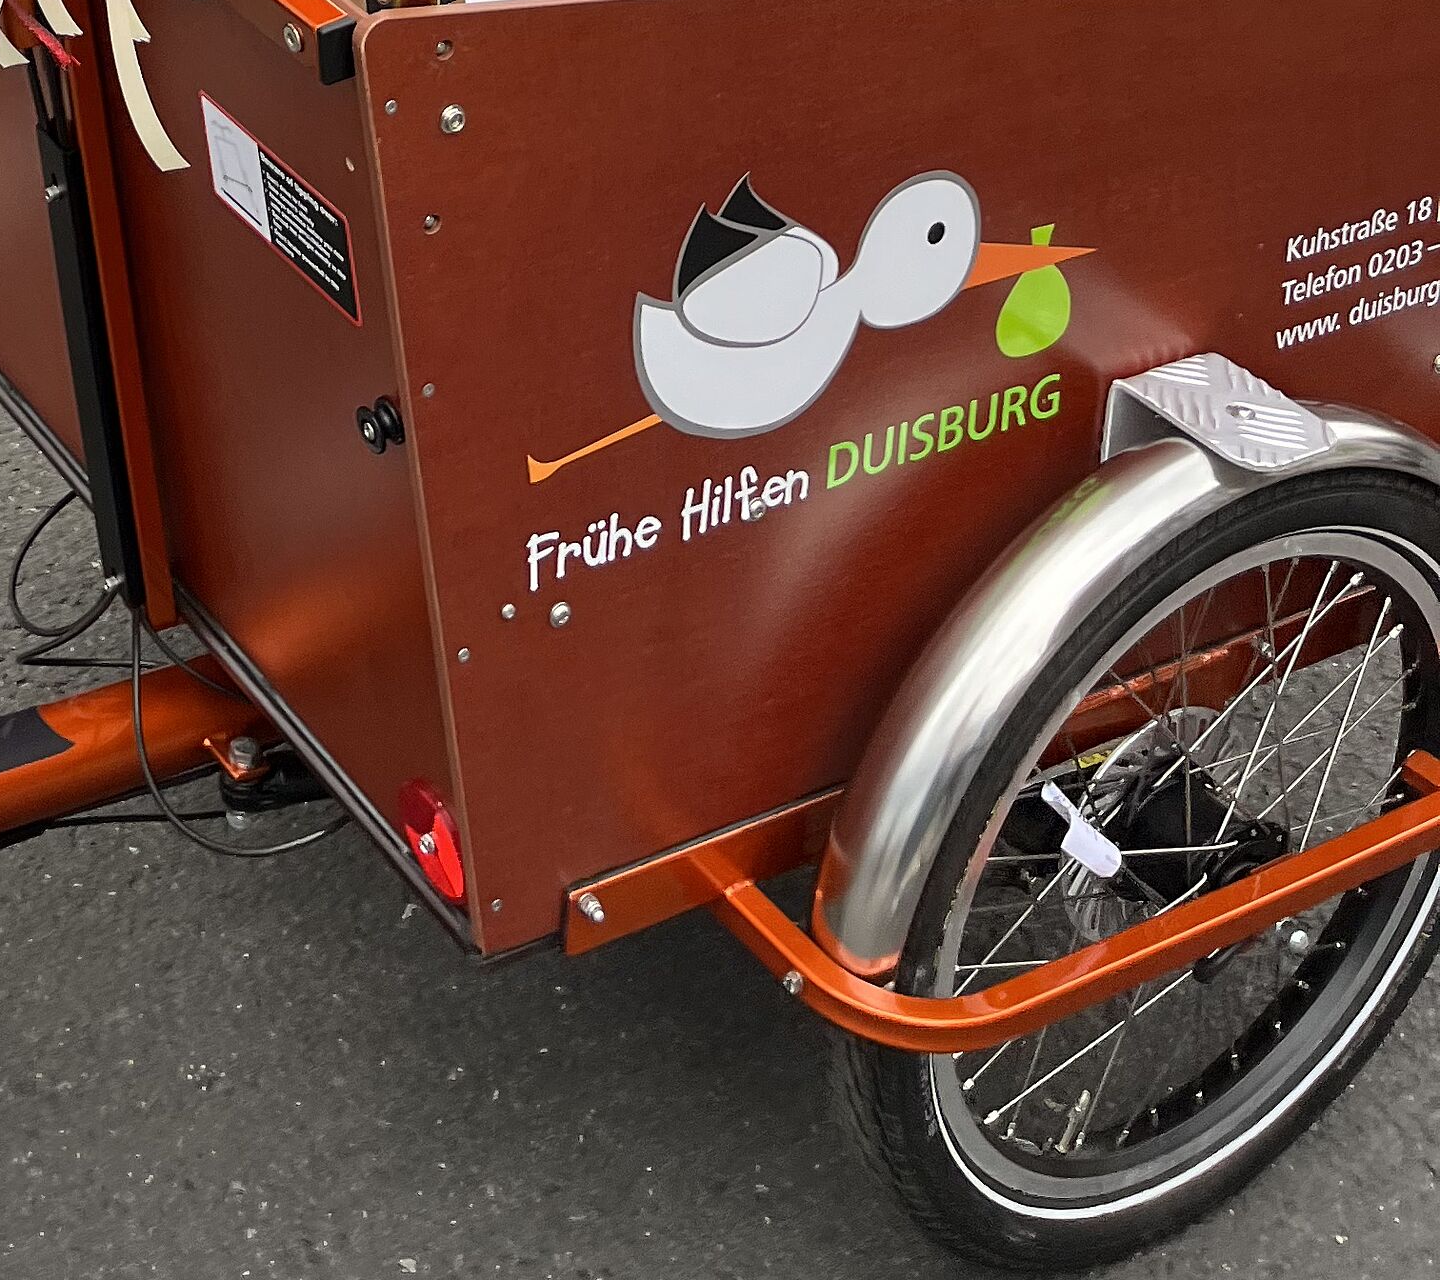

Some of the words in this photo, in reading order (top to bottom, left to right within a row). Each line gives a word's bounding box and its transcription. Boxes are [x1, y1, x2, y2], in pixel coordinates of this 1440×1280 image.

[1286, 209, 1398, 262] Kuhstraße
[1406, 196, 1432, 225] 18
[1281, 264, 1361, 305] Telefon
[1368, 240, 1424, 278] 0203
[1276, 312, 1341, 349] www.
[1348, 279, 1440, 326] duisburg
[526, 511, 662, 592] Frühe
[681, 464, 810, 541] Hilfen
[826, 373, 1060, 489] DUISBURG
